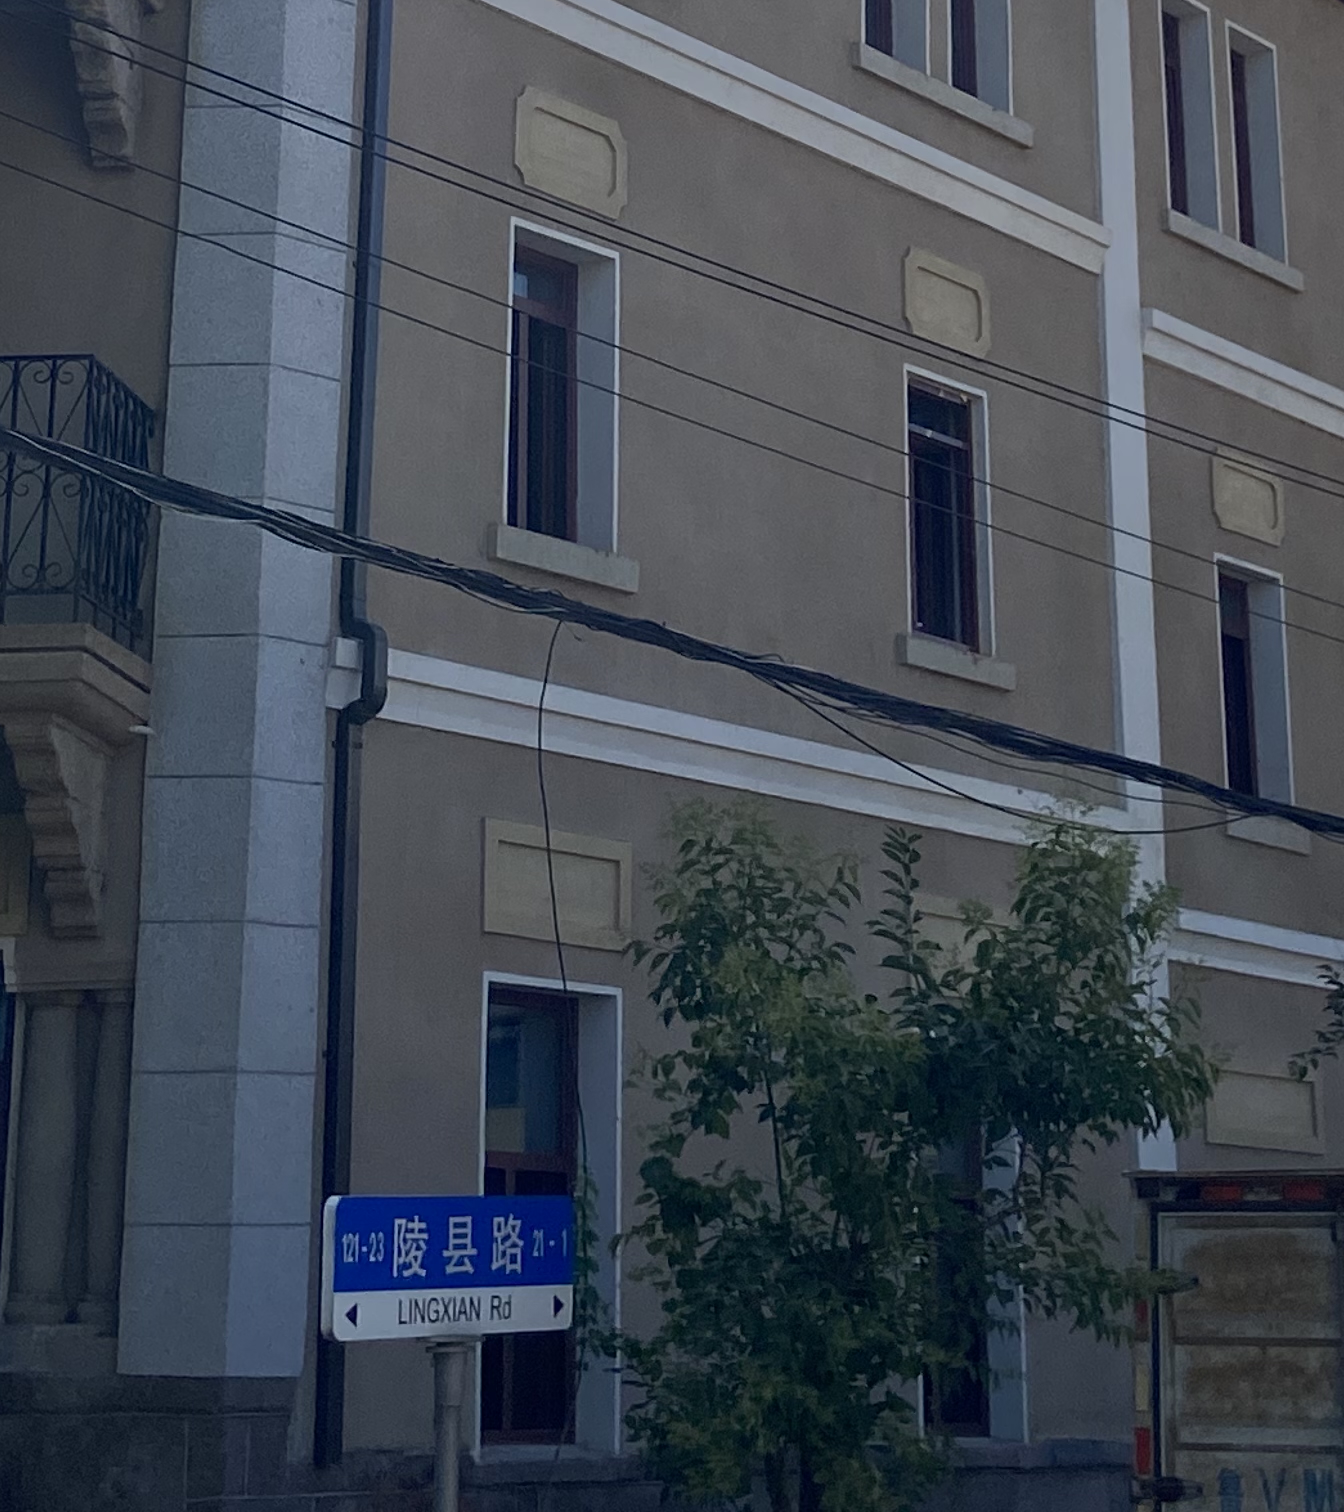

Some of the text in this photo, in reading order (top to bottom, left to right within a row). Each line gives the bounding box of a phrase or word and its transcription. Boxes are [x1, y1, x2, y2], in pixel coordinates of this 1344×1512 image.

[342, 1231, 385, 1263] 121-23
[392, 1213, 524, 1278] 陵县路
[398, 1294, 512, 1325] LINGXIAN Rd
